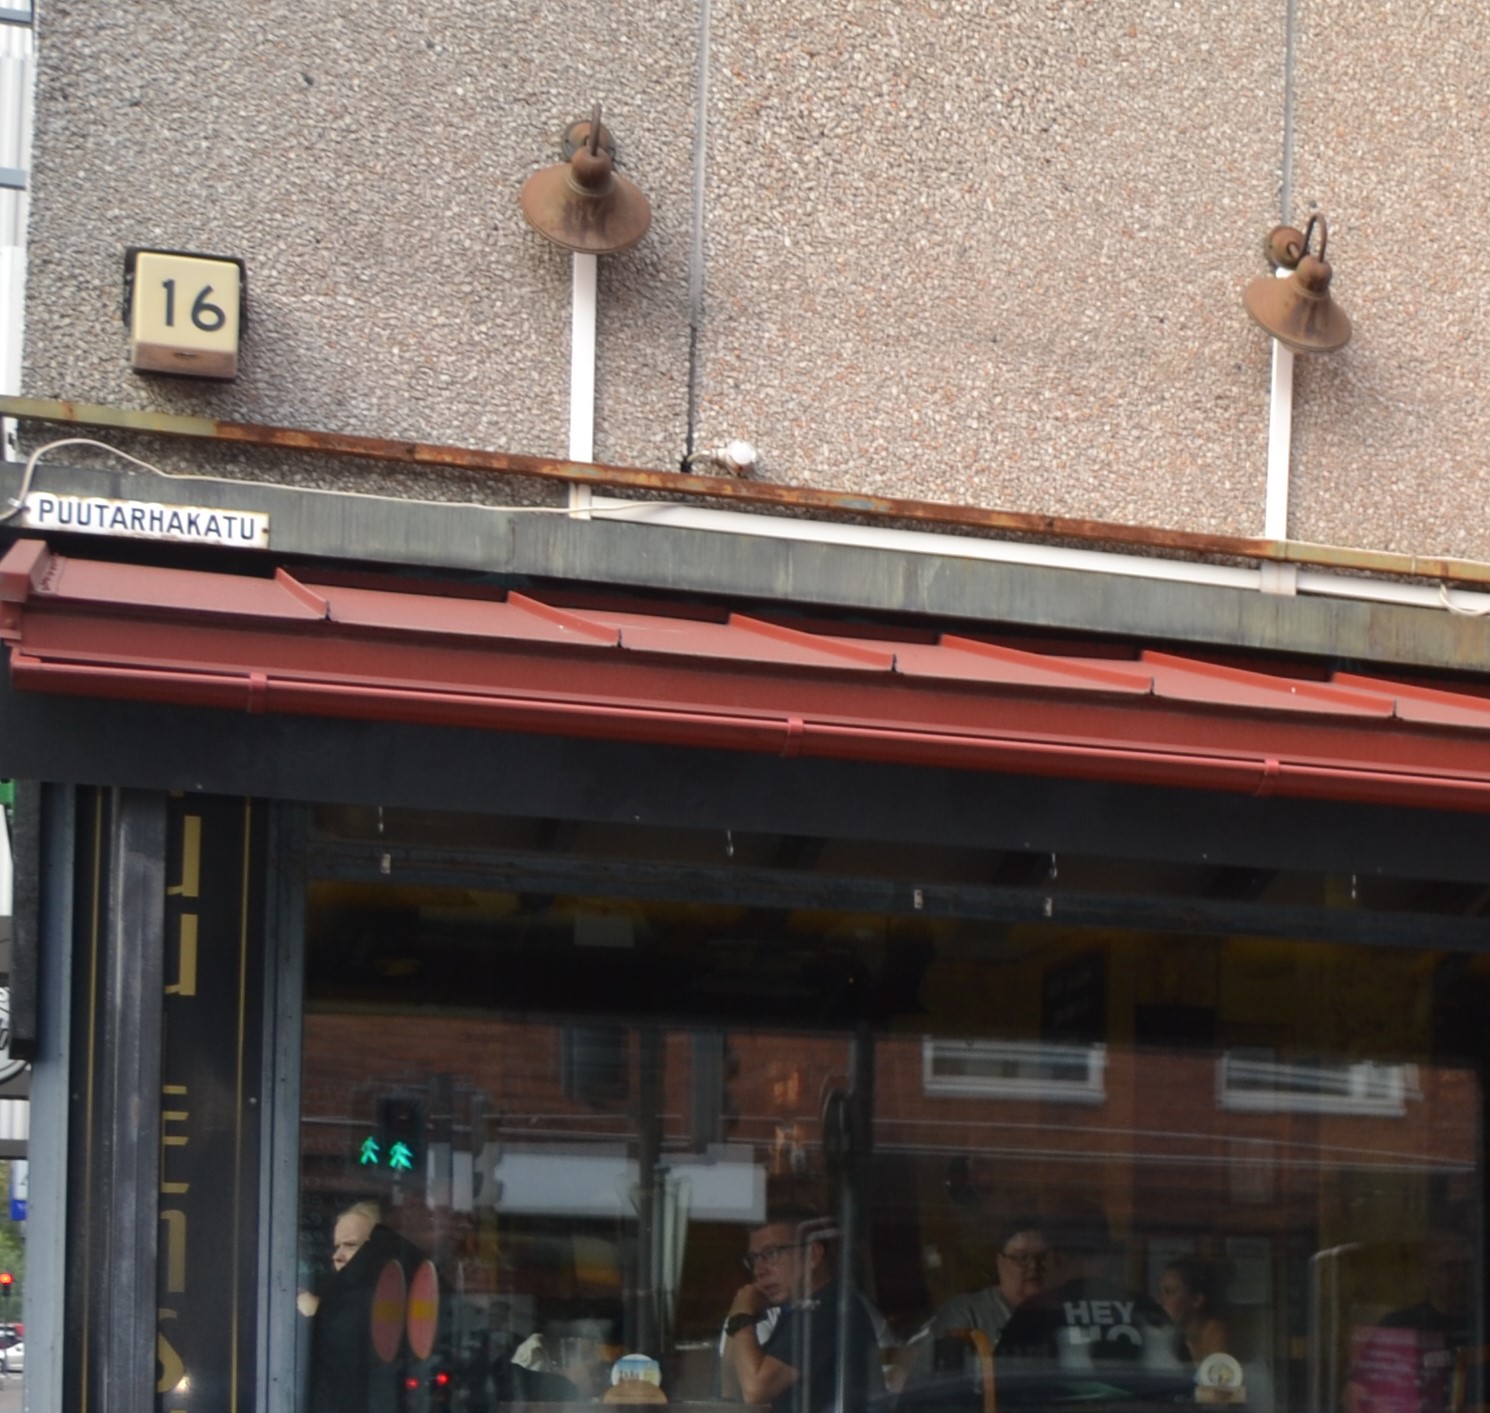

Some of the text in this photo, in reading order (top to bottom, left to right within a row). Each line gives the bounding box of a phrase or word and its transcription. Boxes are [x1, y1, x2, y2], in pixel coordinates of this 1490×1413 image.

[162, 278, 226, 332] 16
[38, 498, 256, 541] PUUTARHAKATU
[1062, 1299, 1135, 1325] HEY
